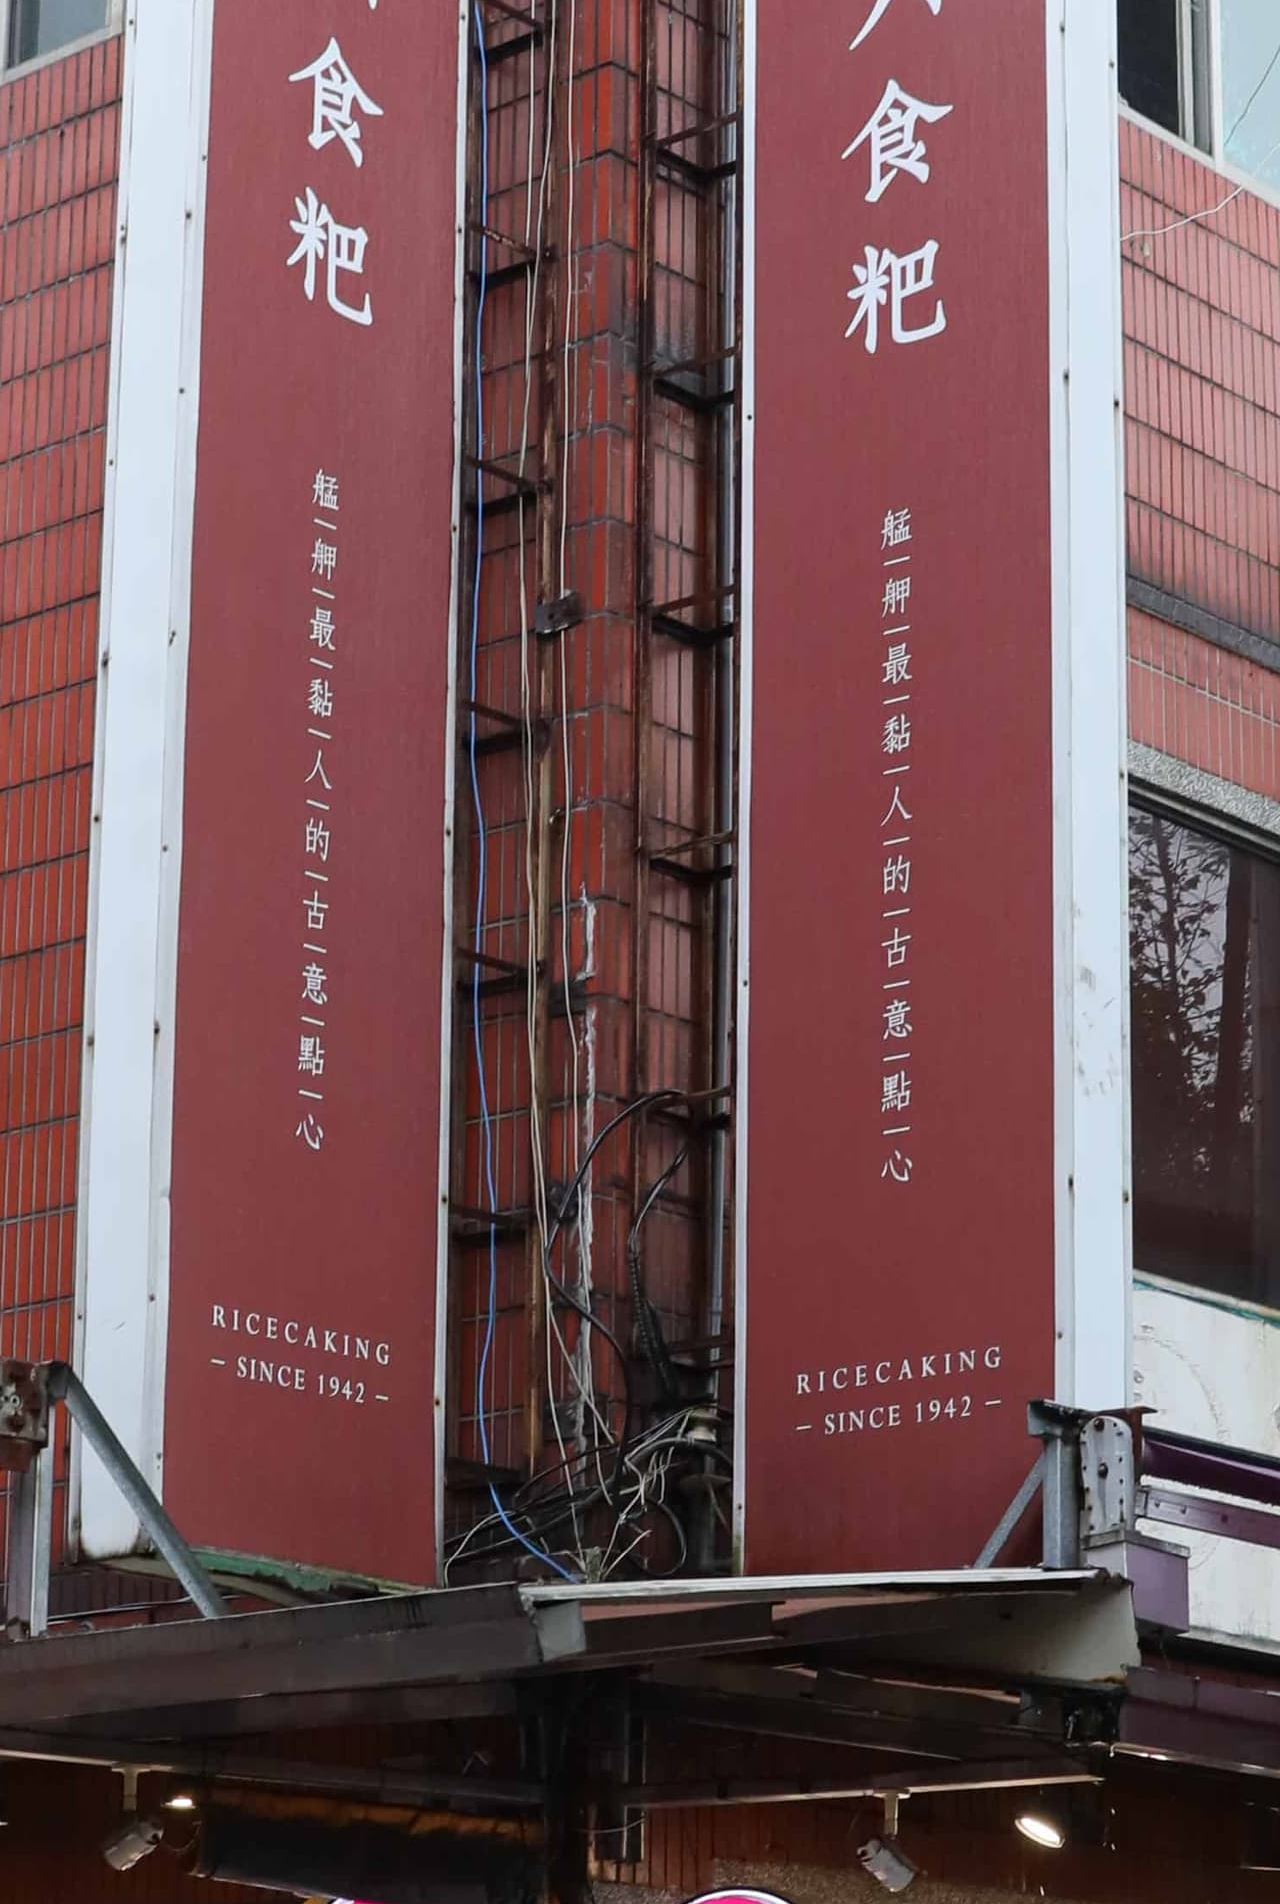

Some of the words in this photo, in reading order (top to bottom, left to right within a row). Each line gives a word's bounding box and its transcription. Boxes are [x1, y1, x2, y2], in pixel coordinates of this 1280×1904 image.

[211, 1304, 390, 1366] RICECAKING
[236, 1355, 306, 1391] SINCE
[317, 1373, 365, 1404] 1942
[796, 1346, 1002, 1395] RICECAKING
[824, 1404, 901, 1435] SINCE
[915, 1395, 972, 1424] 1942
